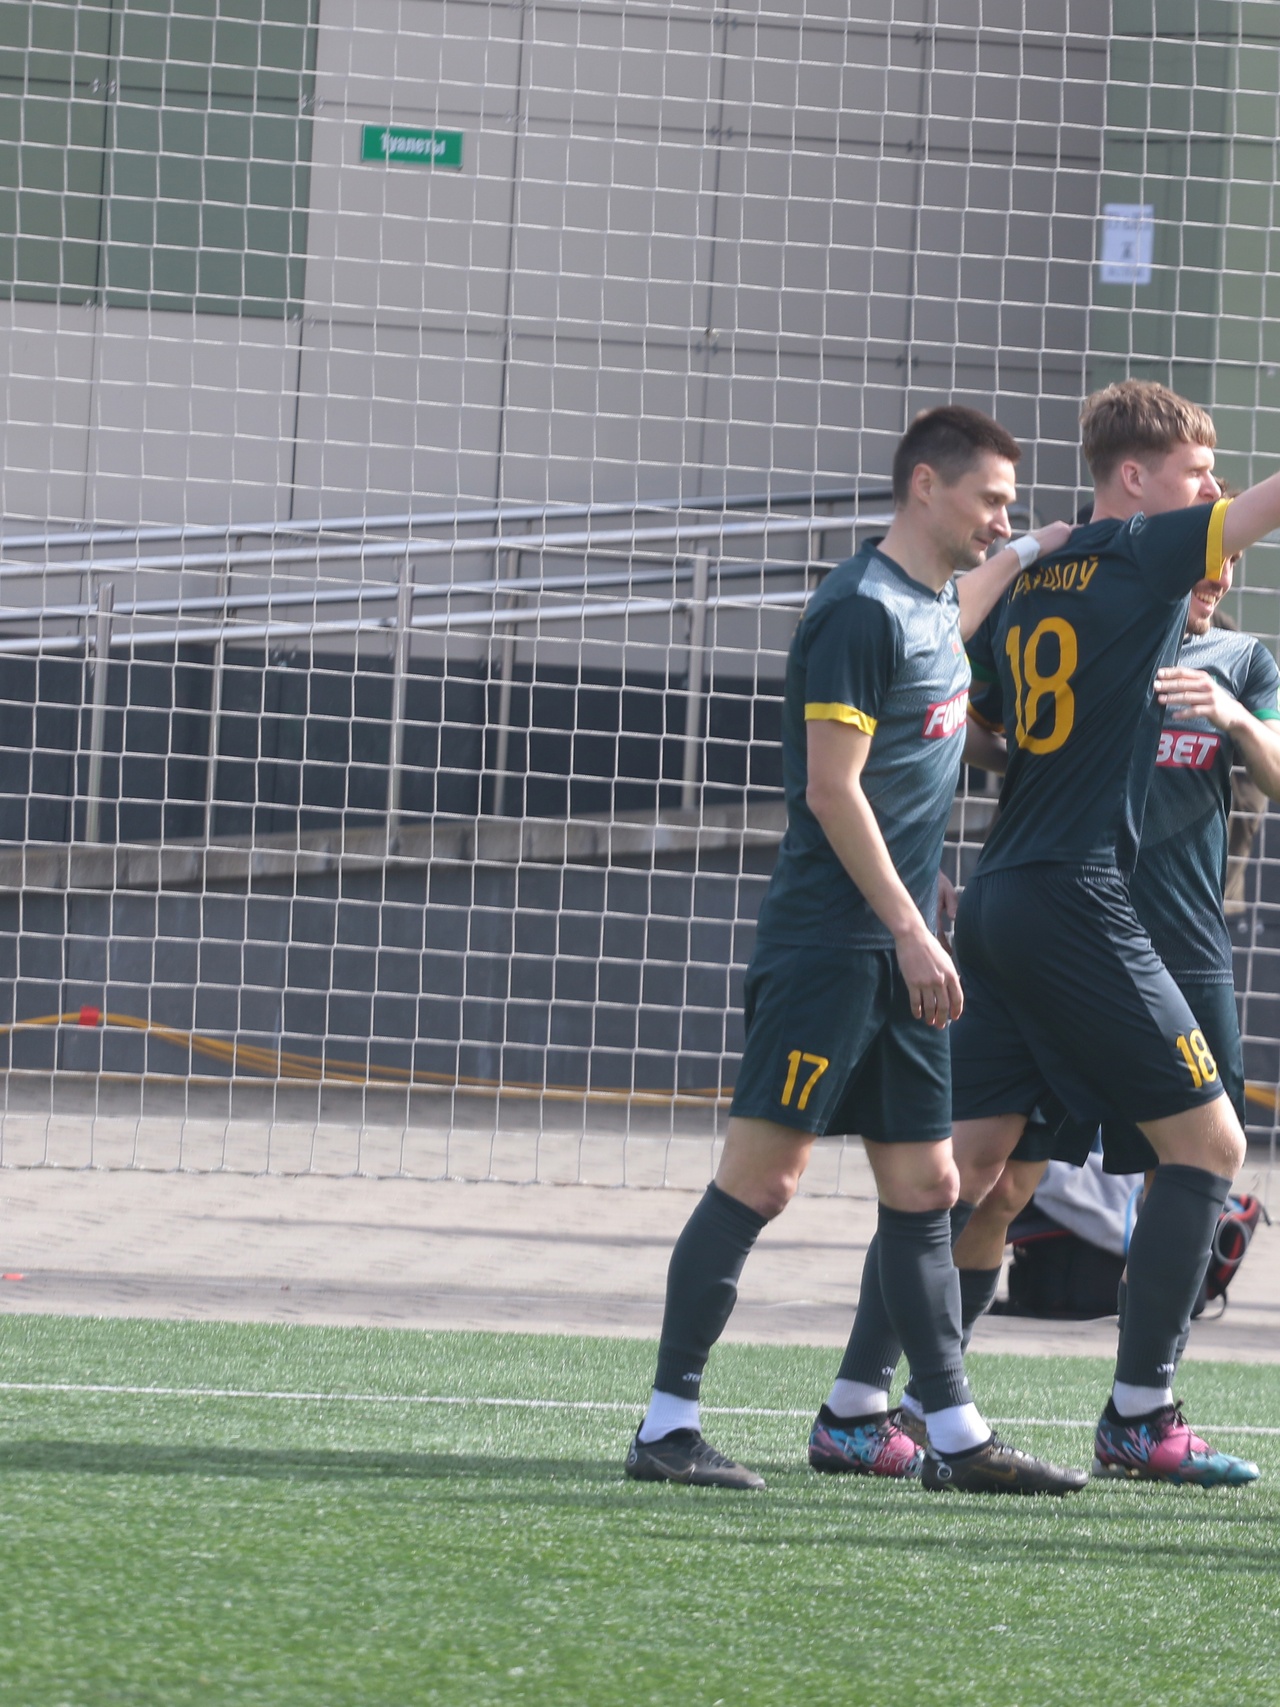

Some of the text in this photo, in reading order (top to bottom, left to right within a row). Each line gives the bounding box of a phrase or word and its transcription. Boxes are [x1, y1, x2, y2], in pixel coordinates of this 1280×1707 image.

[380, 132, 446, 156] Туалеты
[1005, 616, 1078, 756] 18
[1156, 732, 1218, 766] BET
[781, 1049, 829, 1111] 17
[1176, 1028, 1217, 1088] 18
